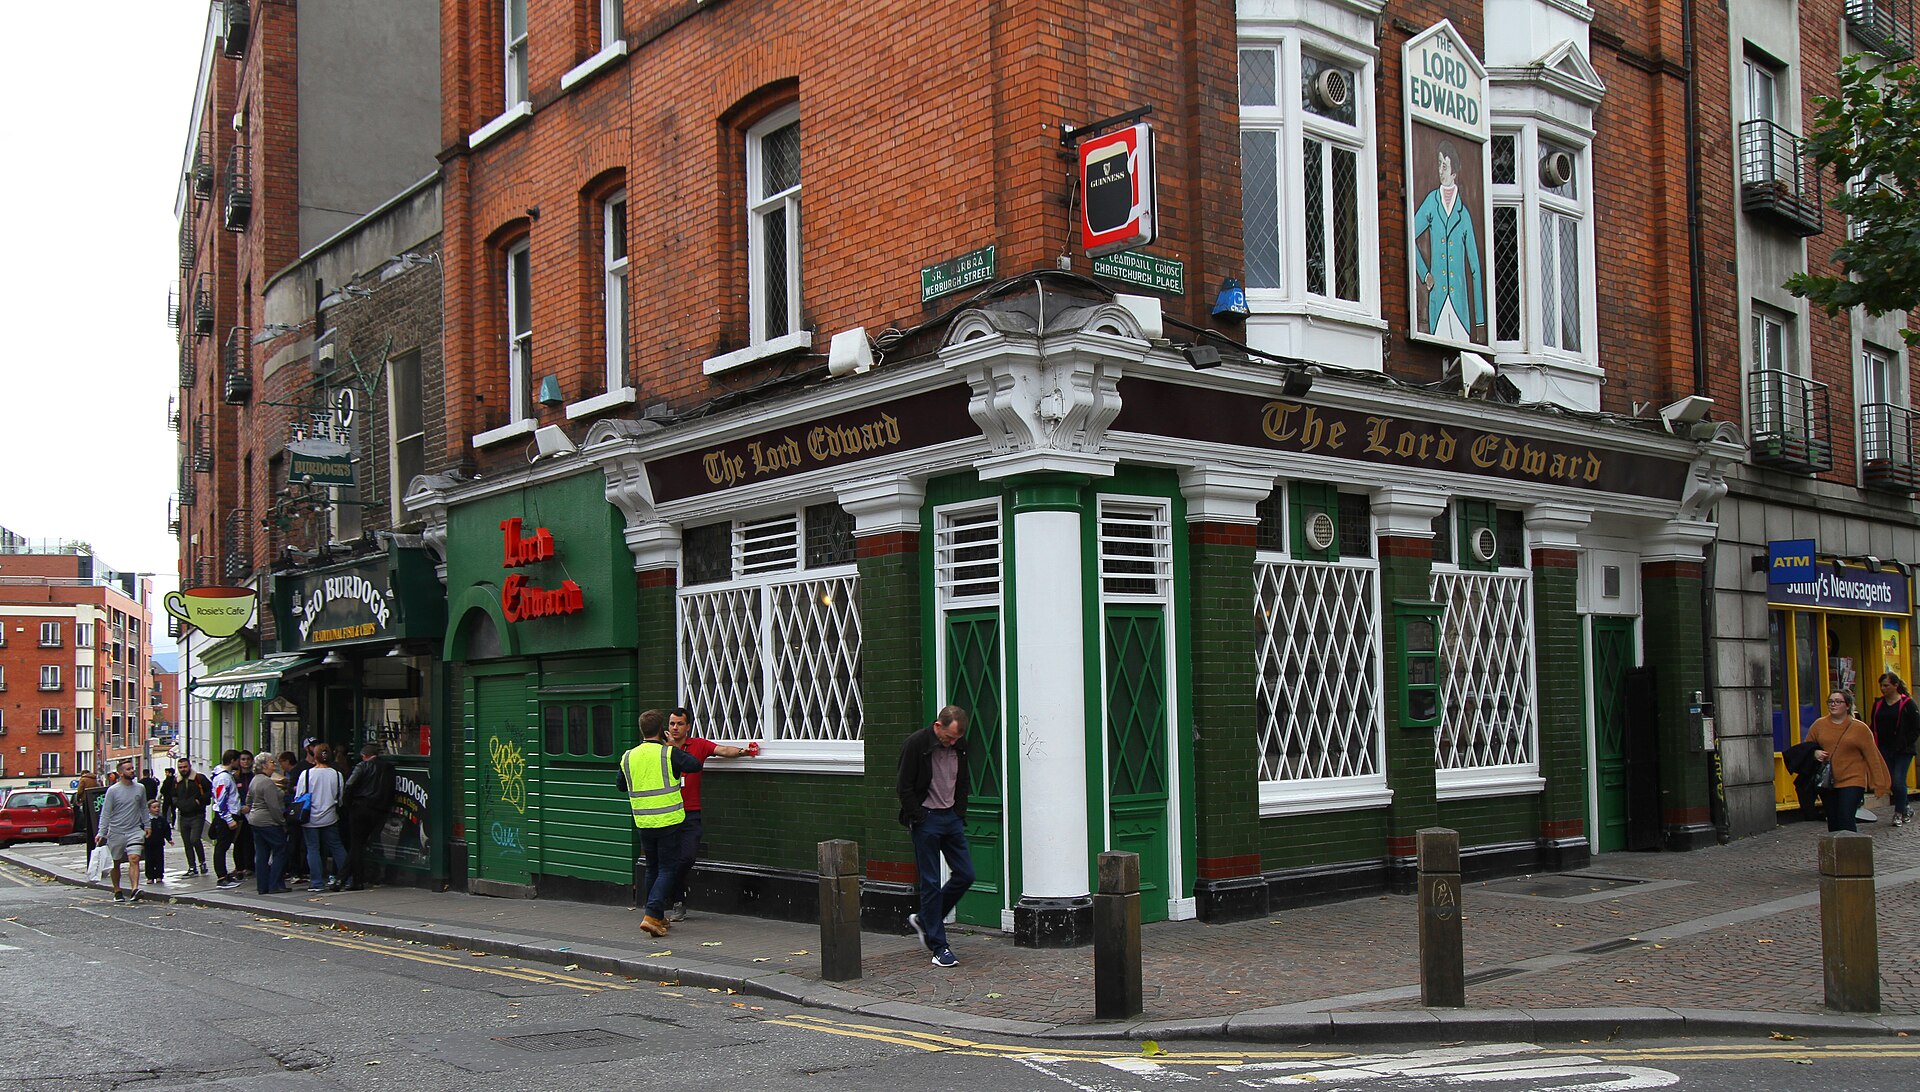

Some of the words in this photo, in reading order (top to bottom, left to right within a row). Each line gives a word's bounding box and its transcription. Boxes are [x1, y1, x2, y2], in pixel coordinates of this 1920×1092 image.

[1435, 34, 1452, 53] THE
[1422, 48, 1467, 90] LORD
[1410, 75, 1478, 126] EDWARD
[1090, 171, 1125, 188] GUINNESS
[925, 276, 962, 297] WERBURGH
[1094, 262, 1152, 284] CHRISTCHURCH
[702, 450, 746, 487] The
[748, 435, 801, 476] Lord
[807, 412, 901, 461] Edward
[1261, 402, 1347, 453] The
[1363, 416, 1457, 463] Lord
[1471, 432, 1602, 483] Edward
[1773, 556, 1810, 568] ATM
[1830, 574, 1892, 607] Newsagents
[196, 606, 224, 616] Rosie's
[225, 606, 245, 616] Cafe
[299, 589, 323, 641] LEO
[324, 575, 390, 630] BURDOCK
[216, 684, 242, 699] OLDEST
[395, 775, 428, 809] RDOCK
